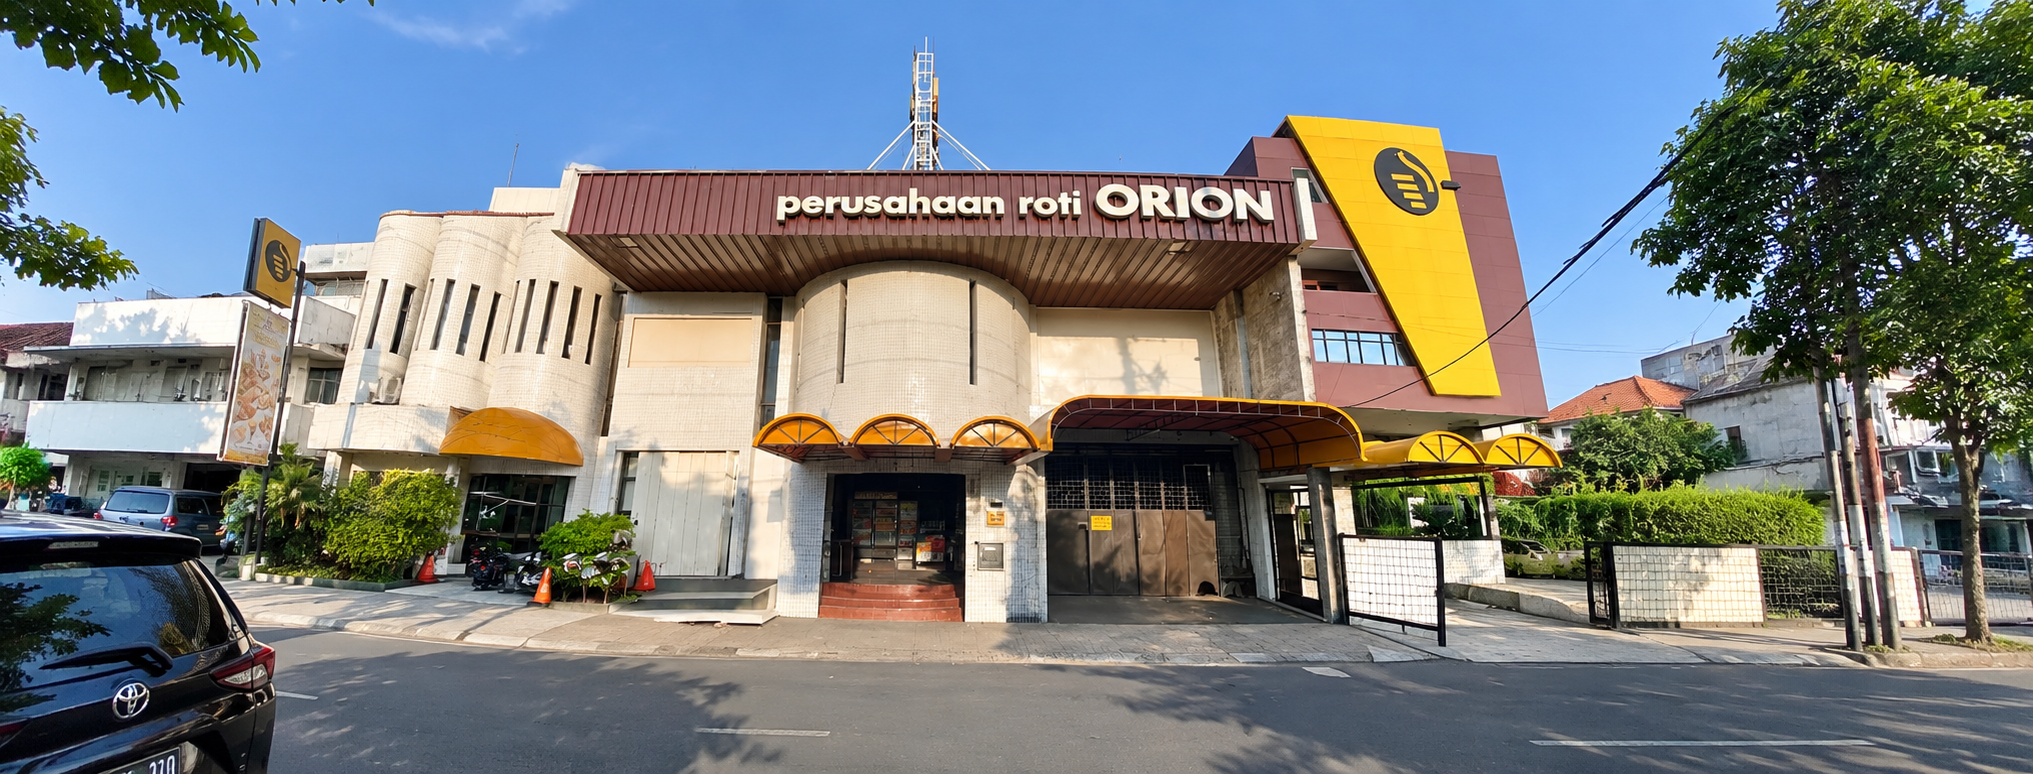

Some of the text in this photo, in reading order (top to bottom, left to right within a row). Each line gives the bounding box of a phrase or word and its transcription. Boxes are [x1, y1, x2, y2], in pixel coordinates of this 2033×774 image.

[776, 183, 1275, 224] perusahaan roti ORION
